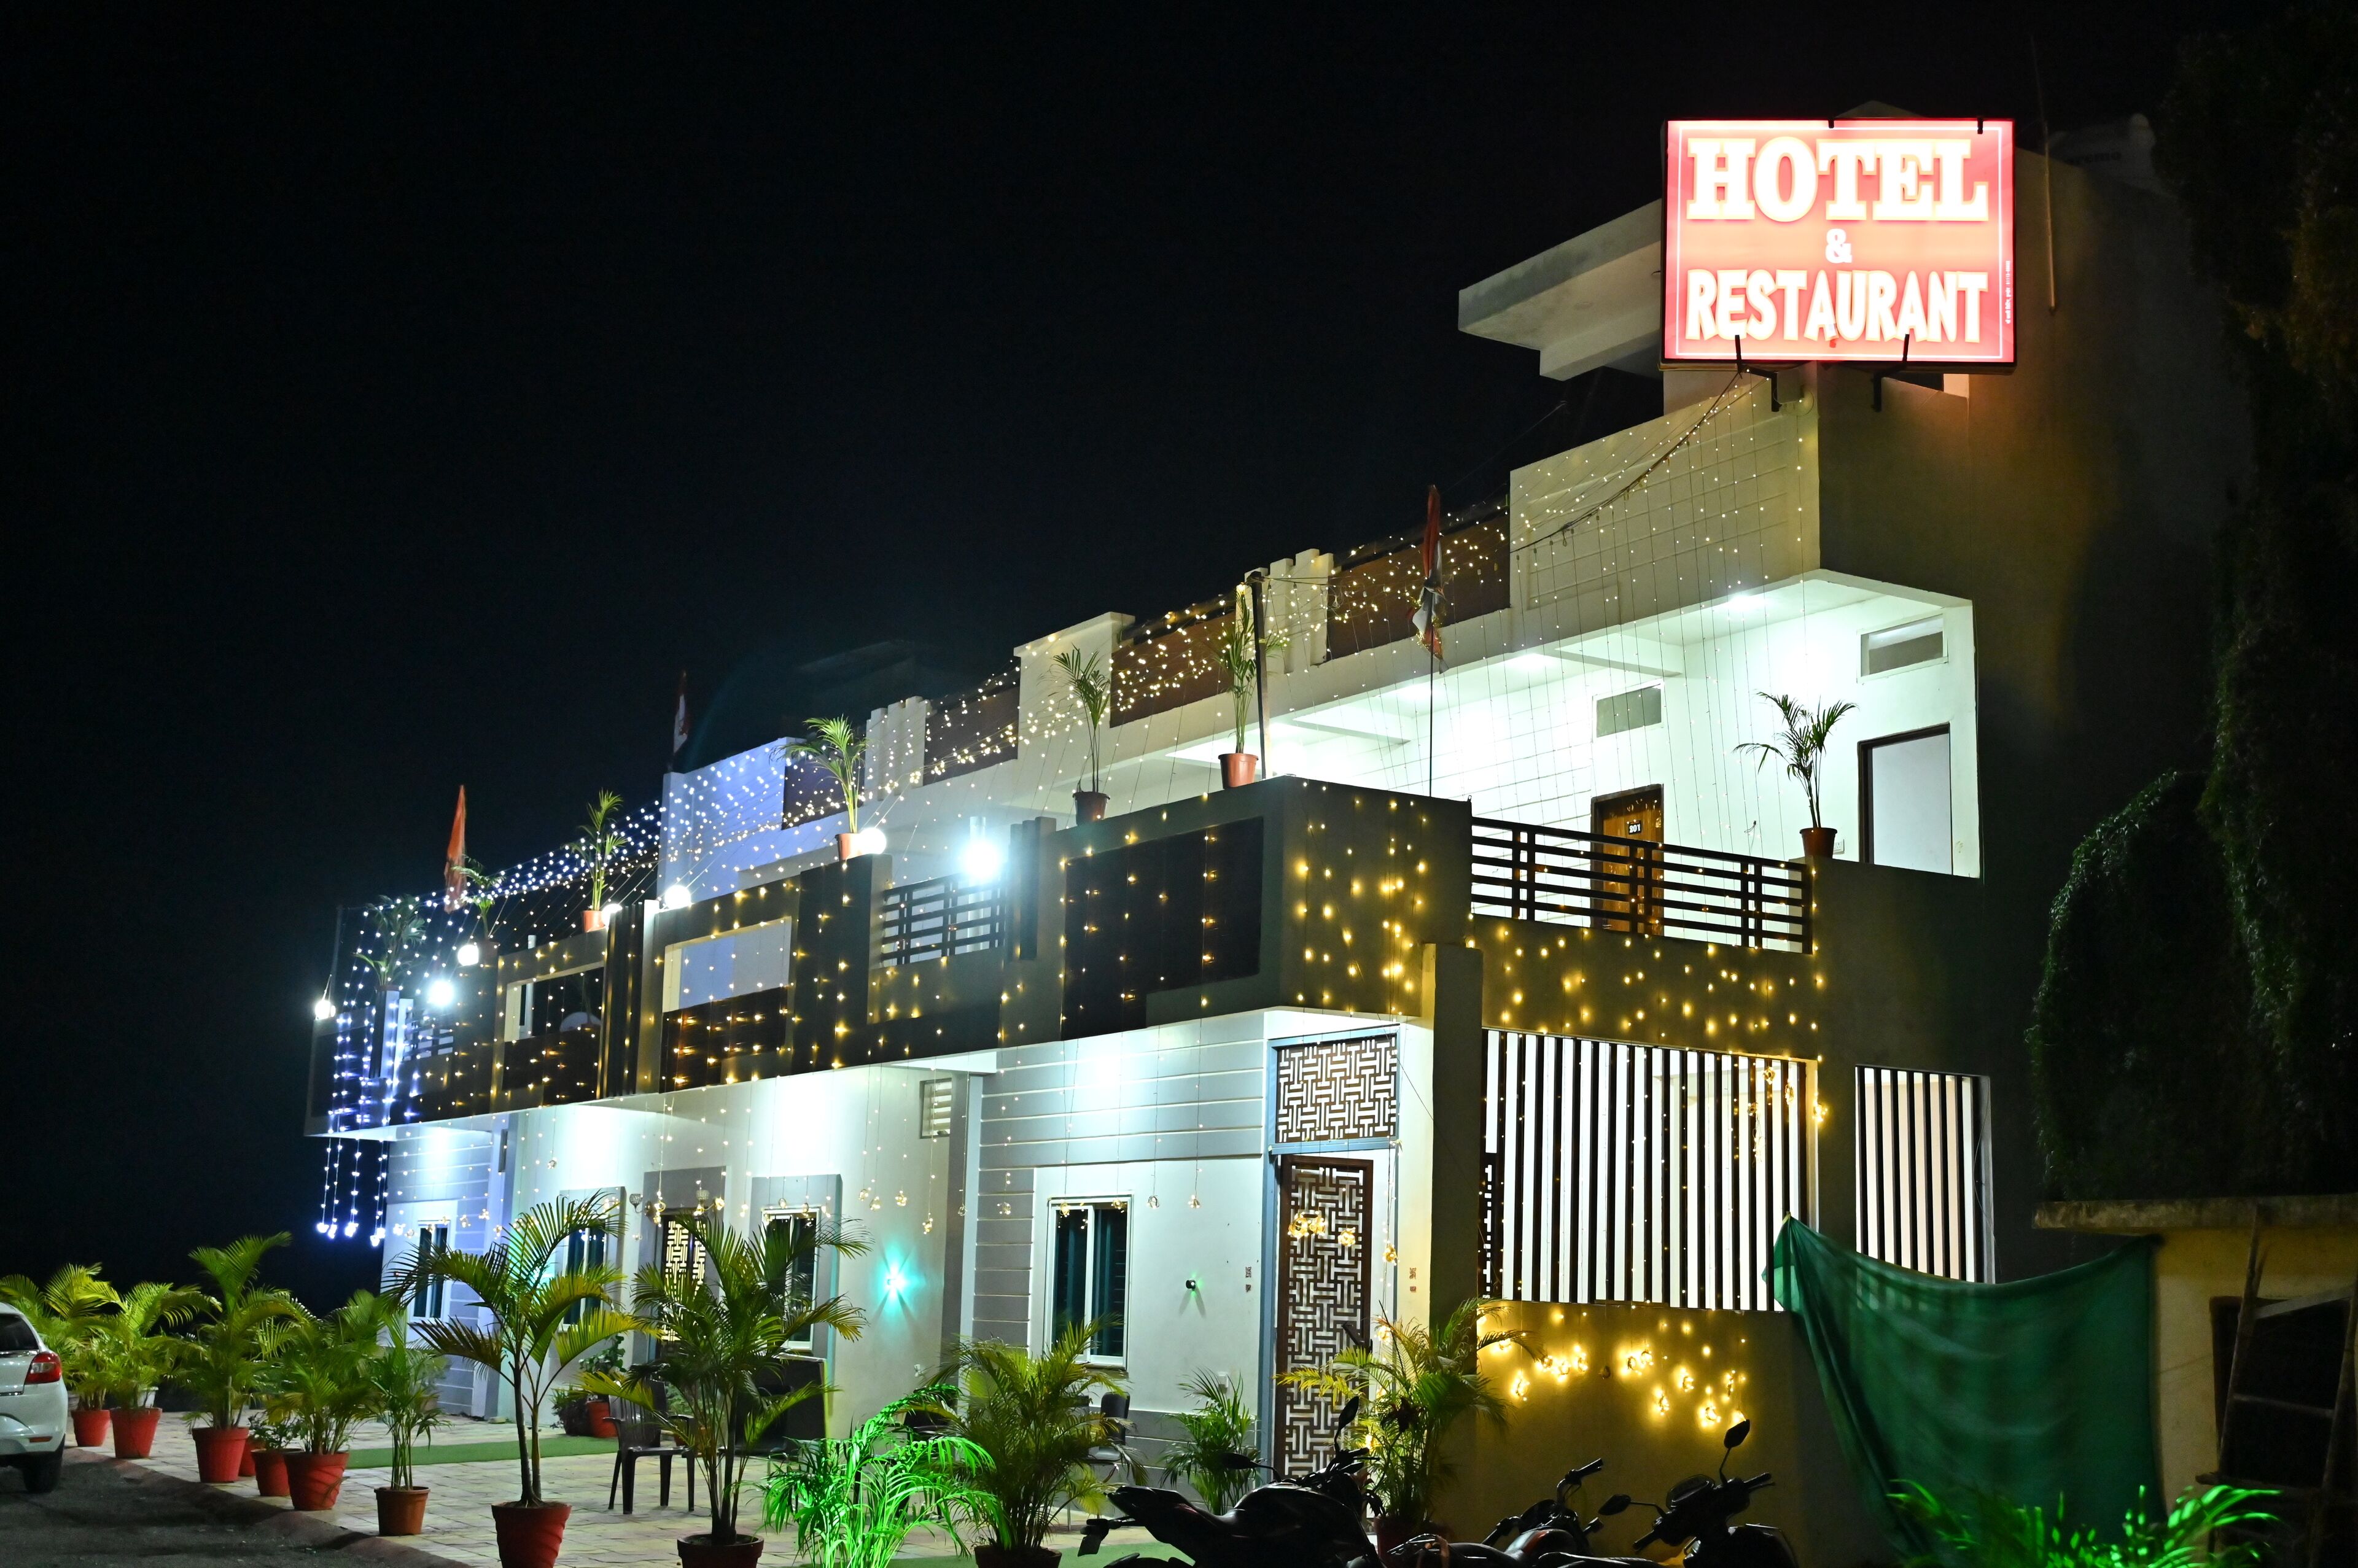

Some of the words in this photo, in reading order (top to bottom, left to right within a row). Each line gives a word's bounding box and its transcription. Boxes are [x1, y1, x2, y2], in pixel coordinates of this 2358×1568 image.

[1686, 136, 1988, 222] HOTEL
[1825, 228, 1852, 263] &
[1686, 269, 1988, 343] RESTAURANT
[1629, 824, 1641, 833] 201
